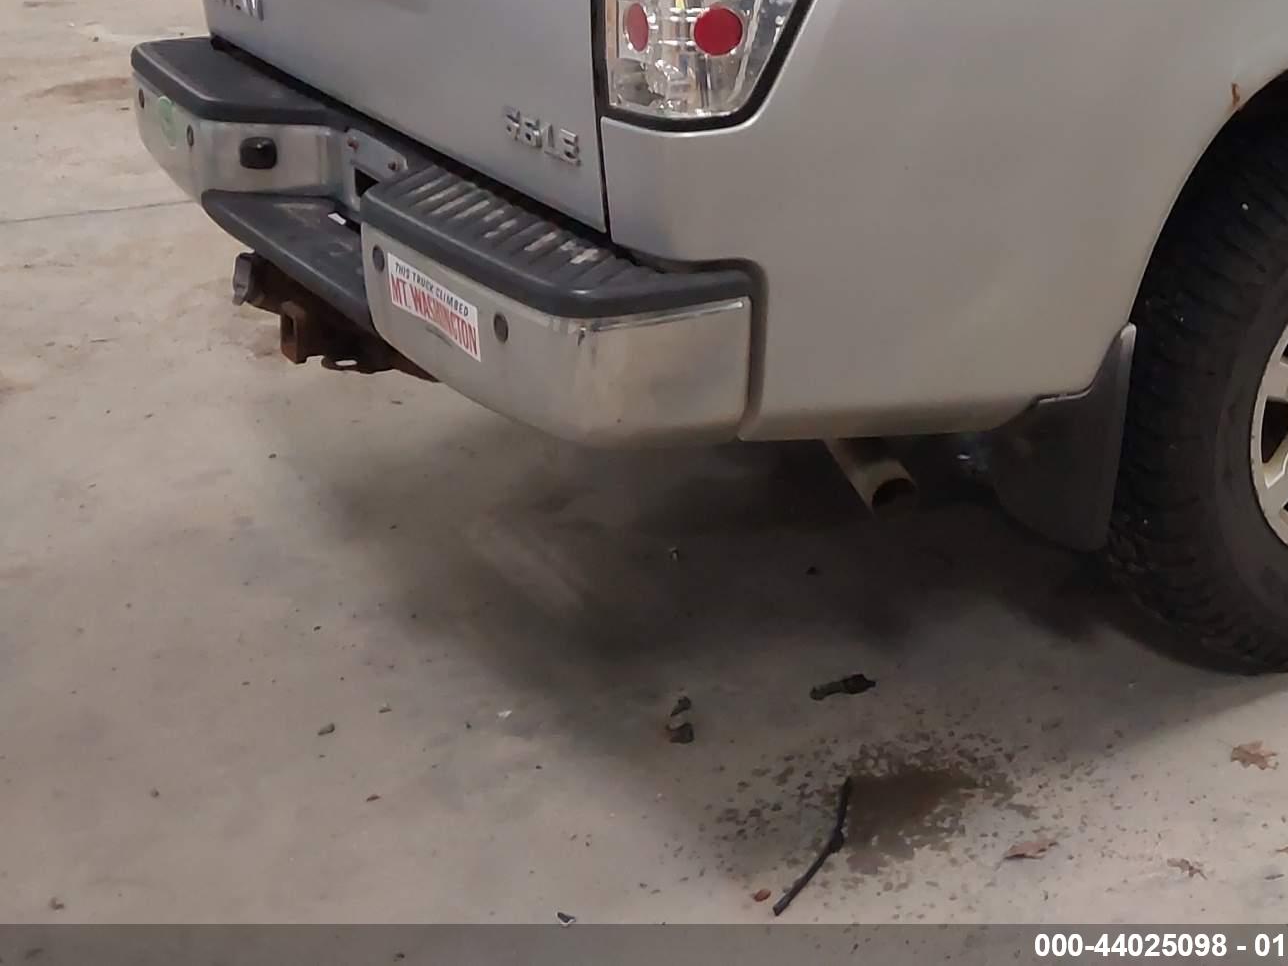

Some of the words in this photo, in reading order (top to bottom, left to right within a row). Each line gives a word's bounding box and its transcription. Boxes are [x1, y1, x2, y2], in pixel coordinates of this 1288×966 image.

[394, 261, 411, 281] THIS
[411, 271, 435, 293] TRUCK
[435, 286, 470, 318] CLIMBED
